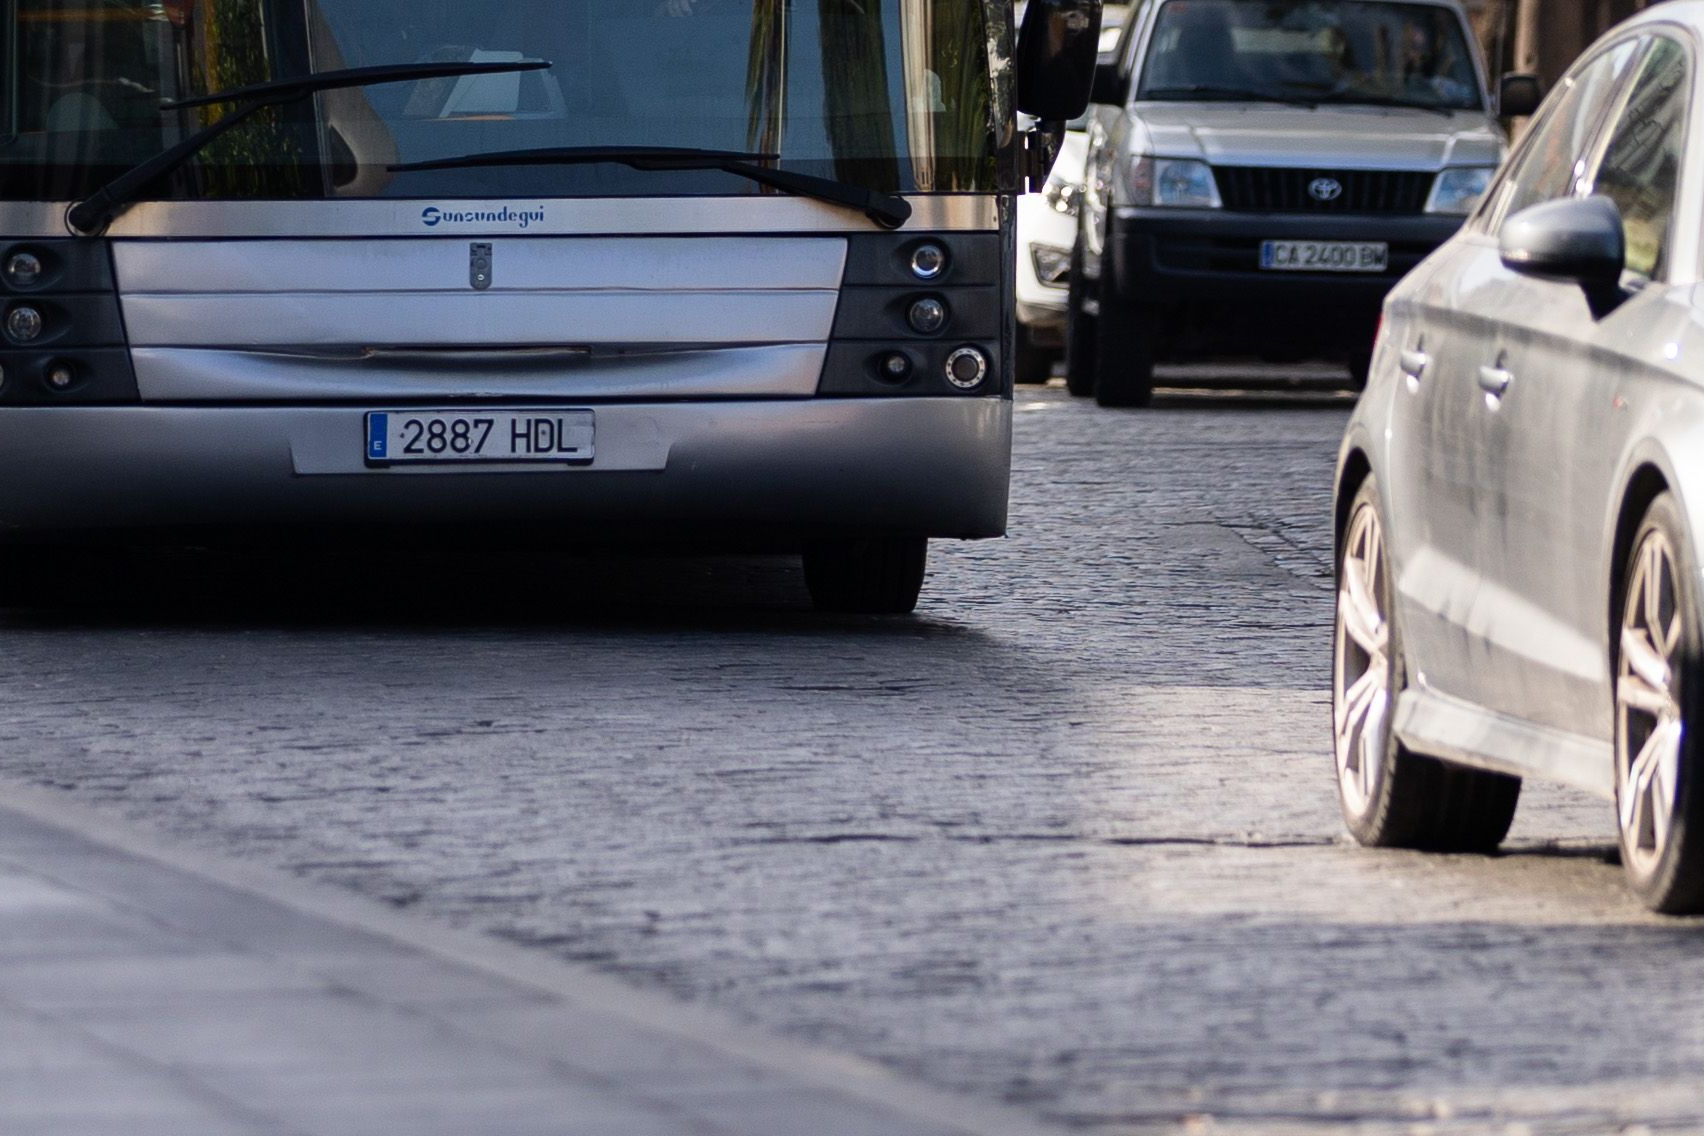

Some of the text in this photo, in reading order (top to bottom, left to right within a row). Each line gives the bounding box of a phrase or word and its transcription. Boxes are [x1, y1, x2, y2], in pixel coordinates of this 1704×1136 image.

[422, 205, 544, 228] Sunsundegui
[403, 419, 494, 454] 2887
[511, 418, 578, 453] HDL
